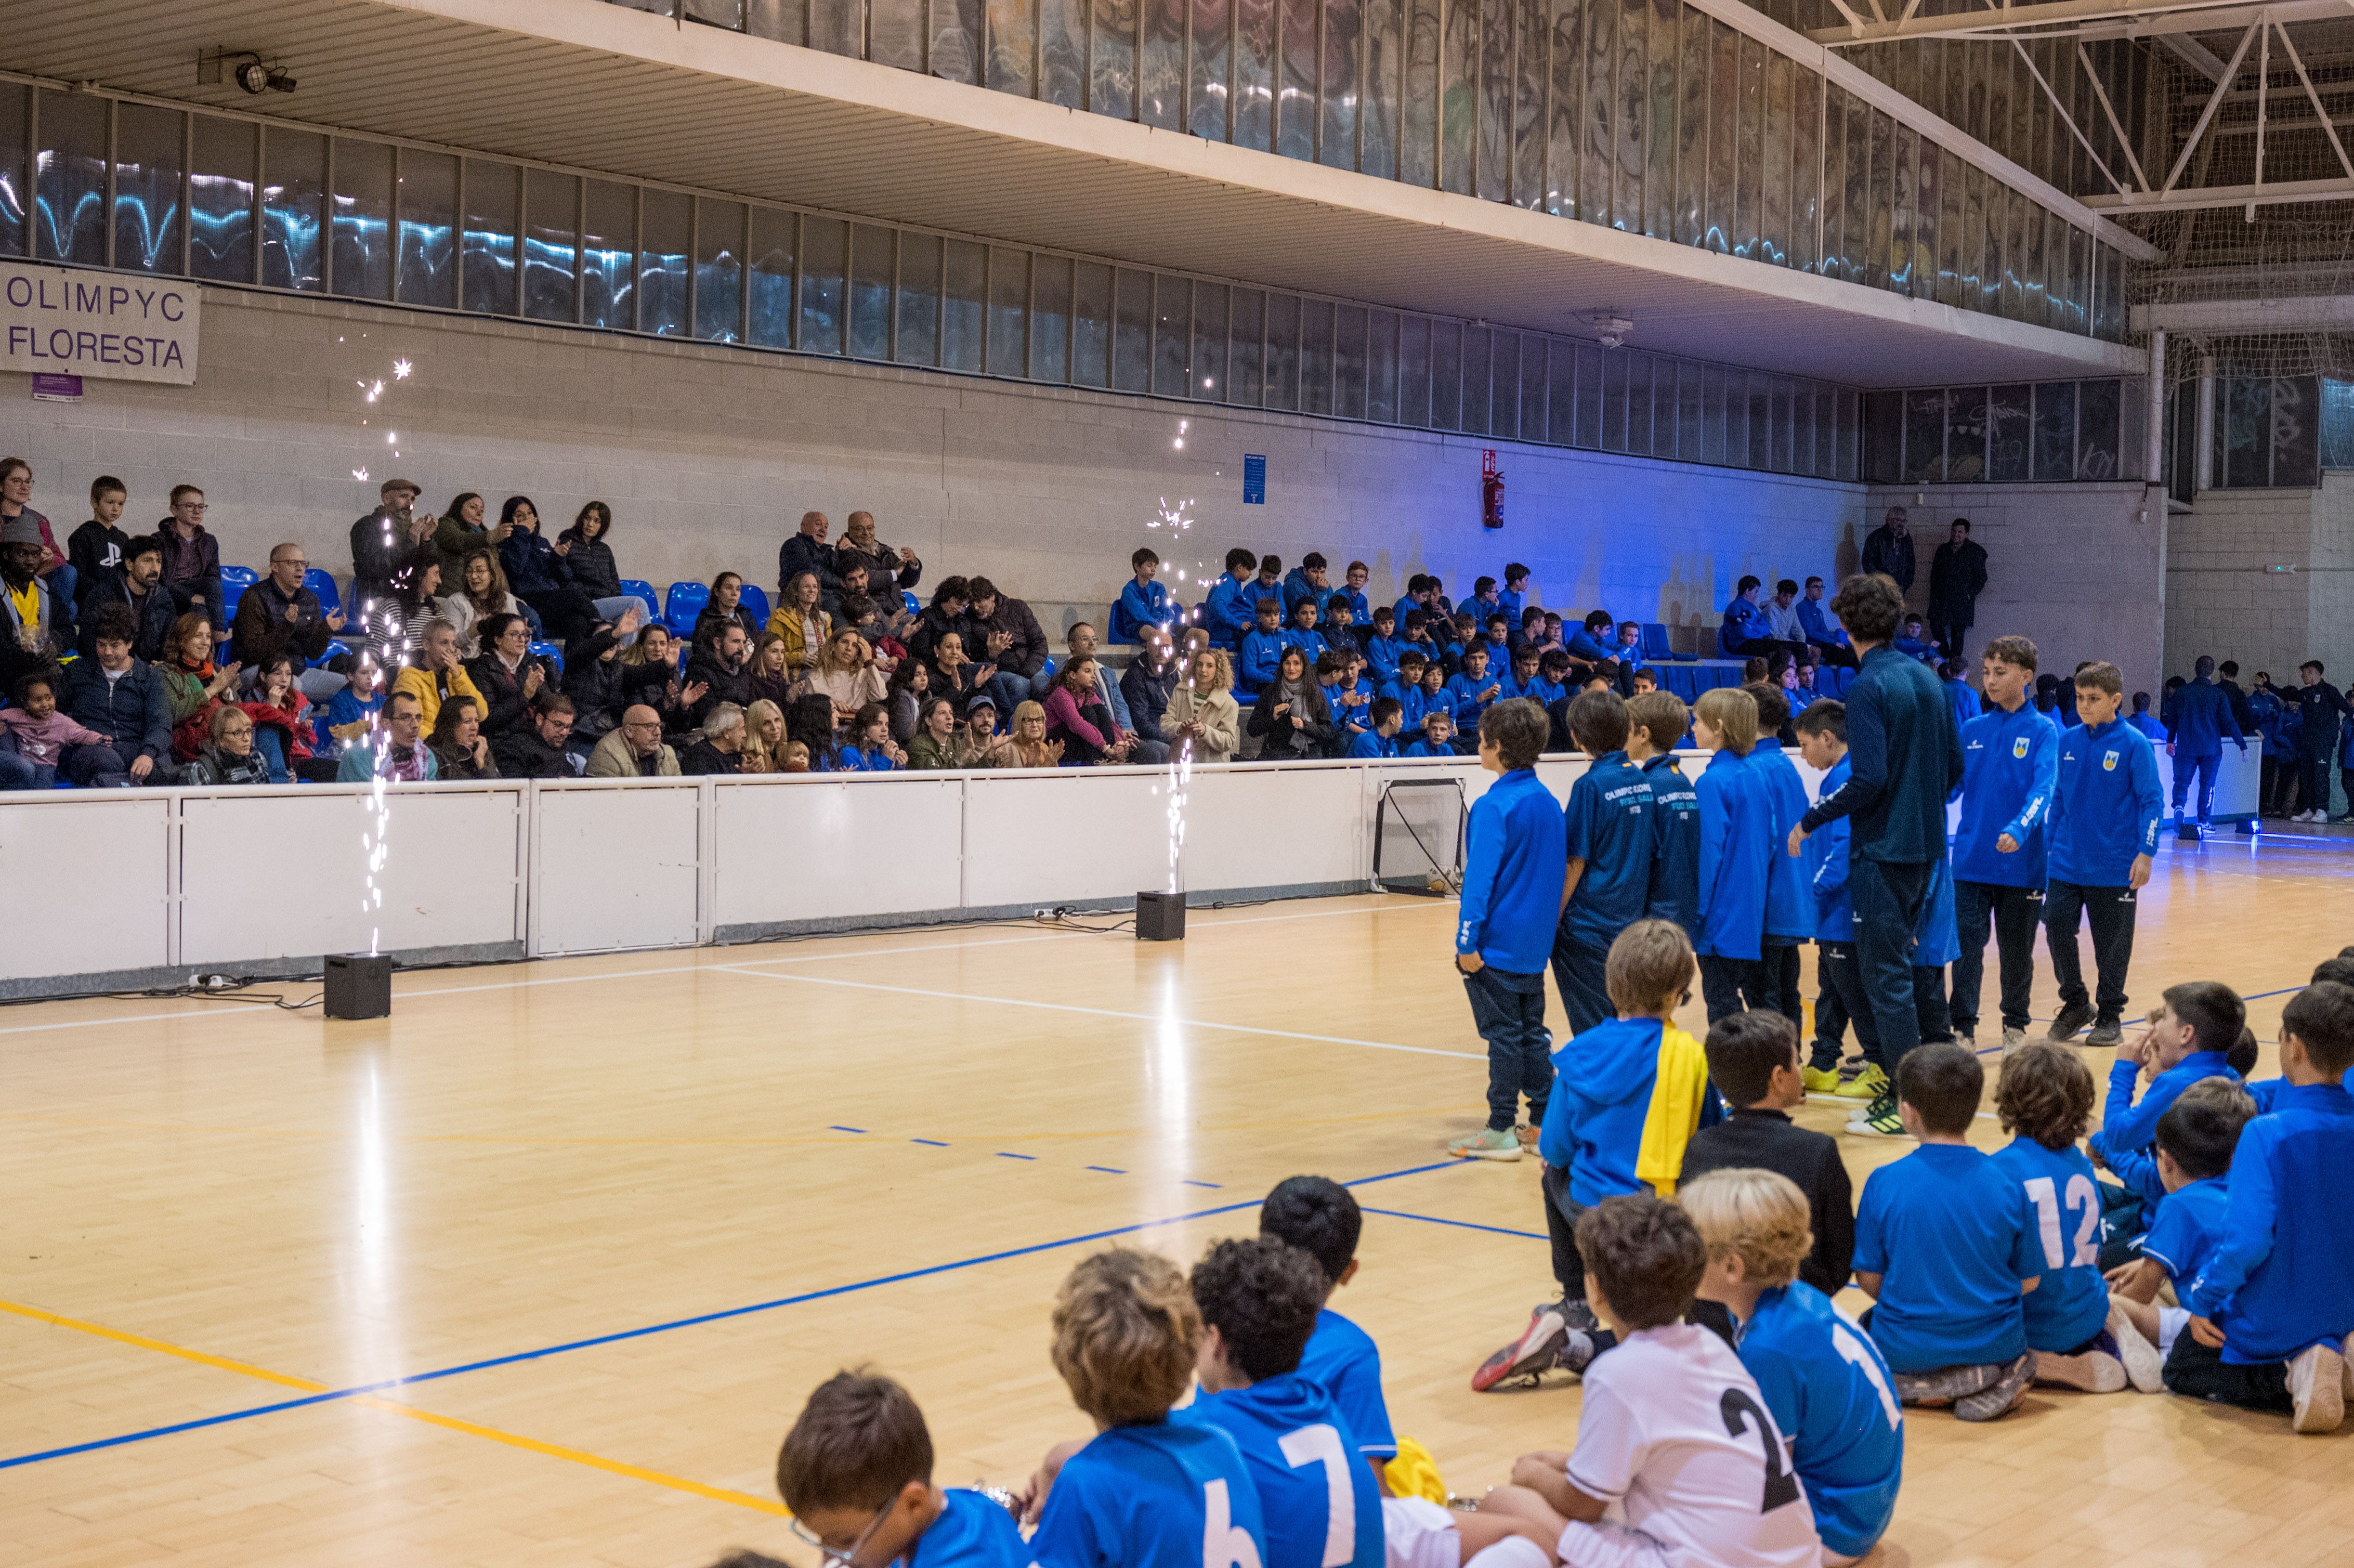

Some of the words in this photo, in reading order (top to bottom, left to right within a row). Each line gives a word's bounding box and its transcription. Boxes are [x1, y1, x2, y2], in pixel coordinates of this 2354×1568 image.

[7, 276, 185, 322] OLIMPYC
[9, 326, 184, 369] FLORESTA
[2023, 1173, 2100, 1270] 12
[1277, 1423, 1355, 1568] 7
[1720, 1388, 1801, 1514] 2
